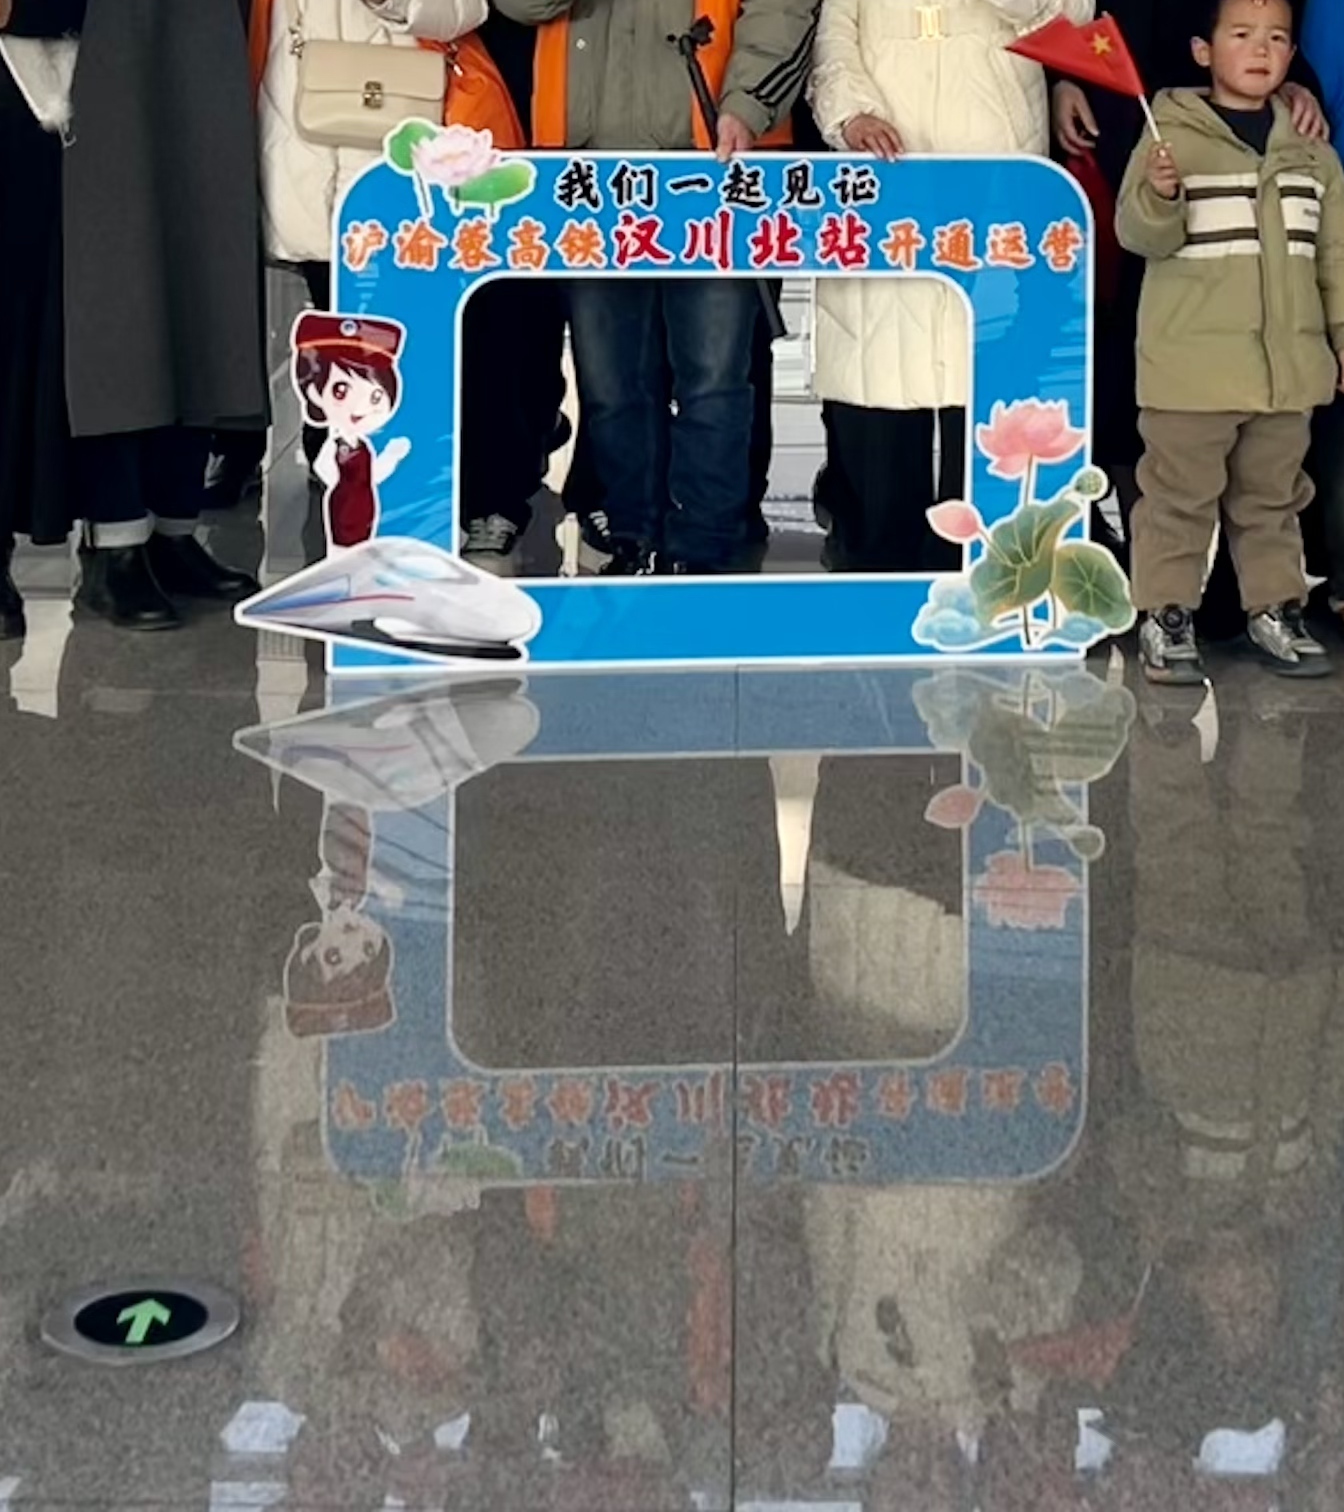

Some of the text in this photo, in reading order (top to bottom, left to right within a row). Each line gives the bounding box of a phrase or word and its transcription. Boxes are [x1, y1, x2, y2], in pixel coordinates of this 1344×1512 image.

[556, 161, 878, 209] 我们一起见证
[344, 210, 1084, 269] 沪渝蓉高铁汉川北站开通运营
